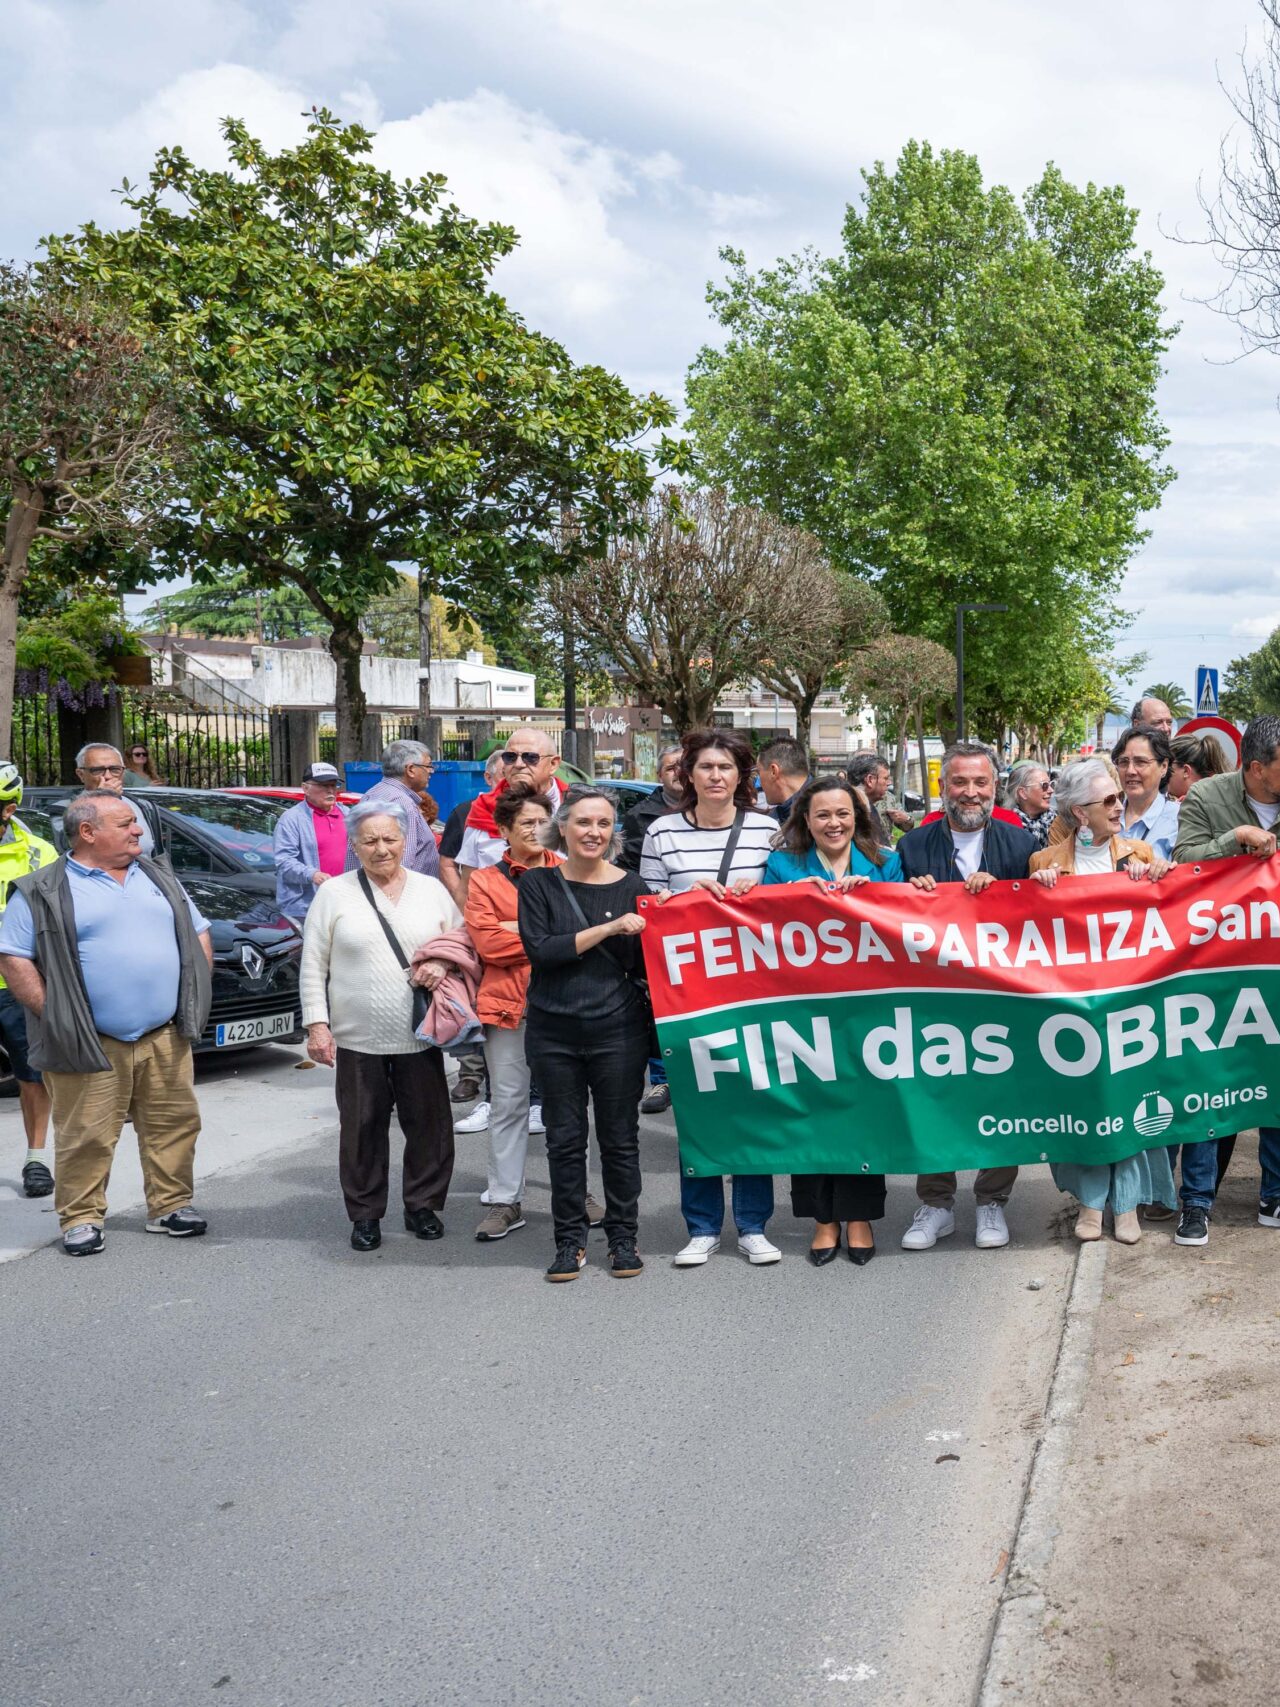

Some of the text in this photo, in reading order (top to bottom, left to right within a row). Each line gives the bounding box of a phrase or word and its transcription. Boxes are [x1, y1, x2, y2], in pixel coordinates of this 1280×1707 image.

[662, 918, 896, 985] FENOSA
[902, 907, 1176, 969] PARALIZA
[228, 1015, 291, 1041] 4220 JRV
[688, 1016, 837, 1093] FIN
[862, 1006, 1015, 1080] das
[978, 1084, 1268, 1137] Concello de Oleiros
